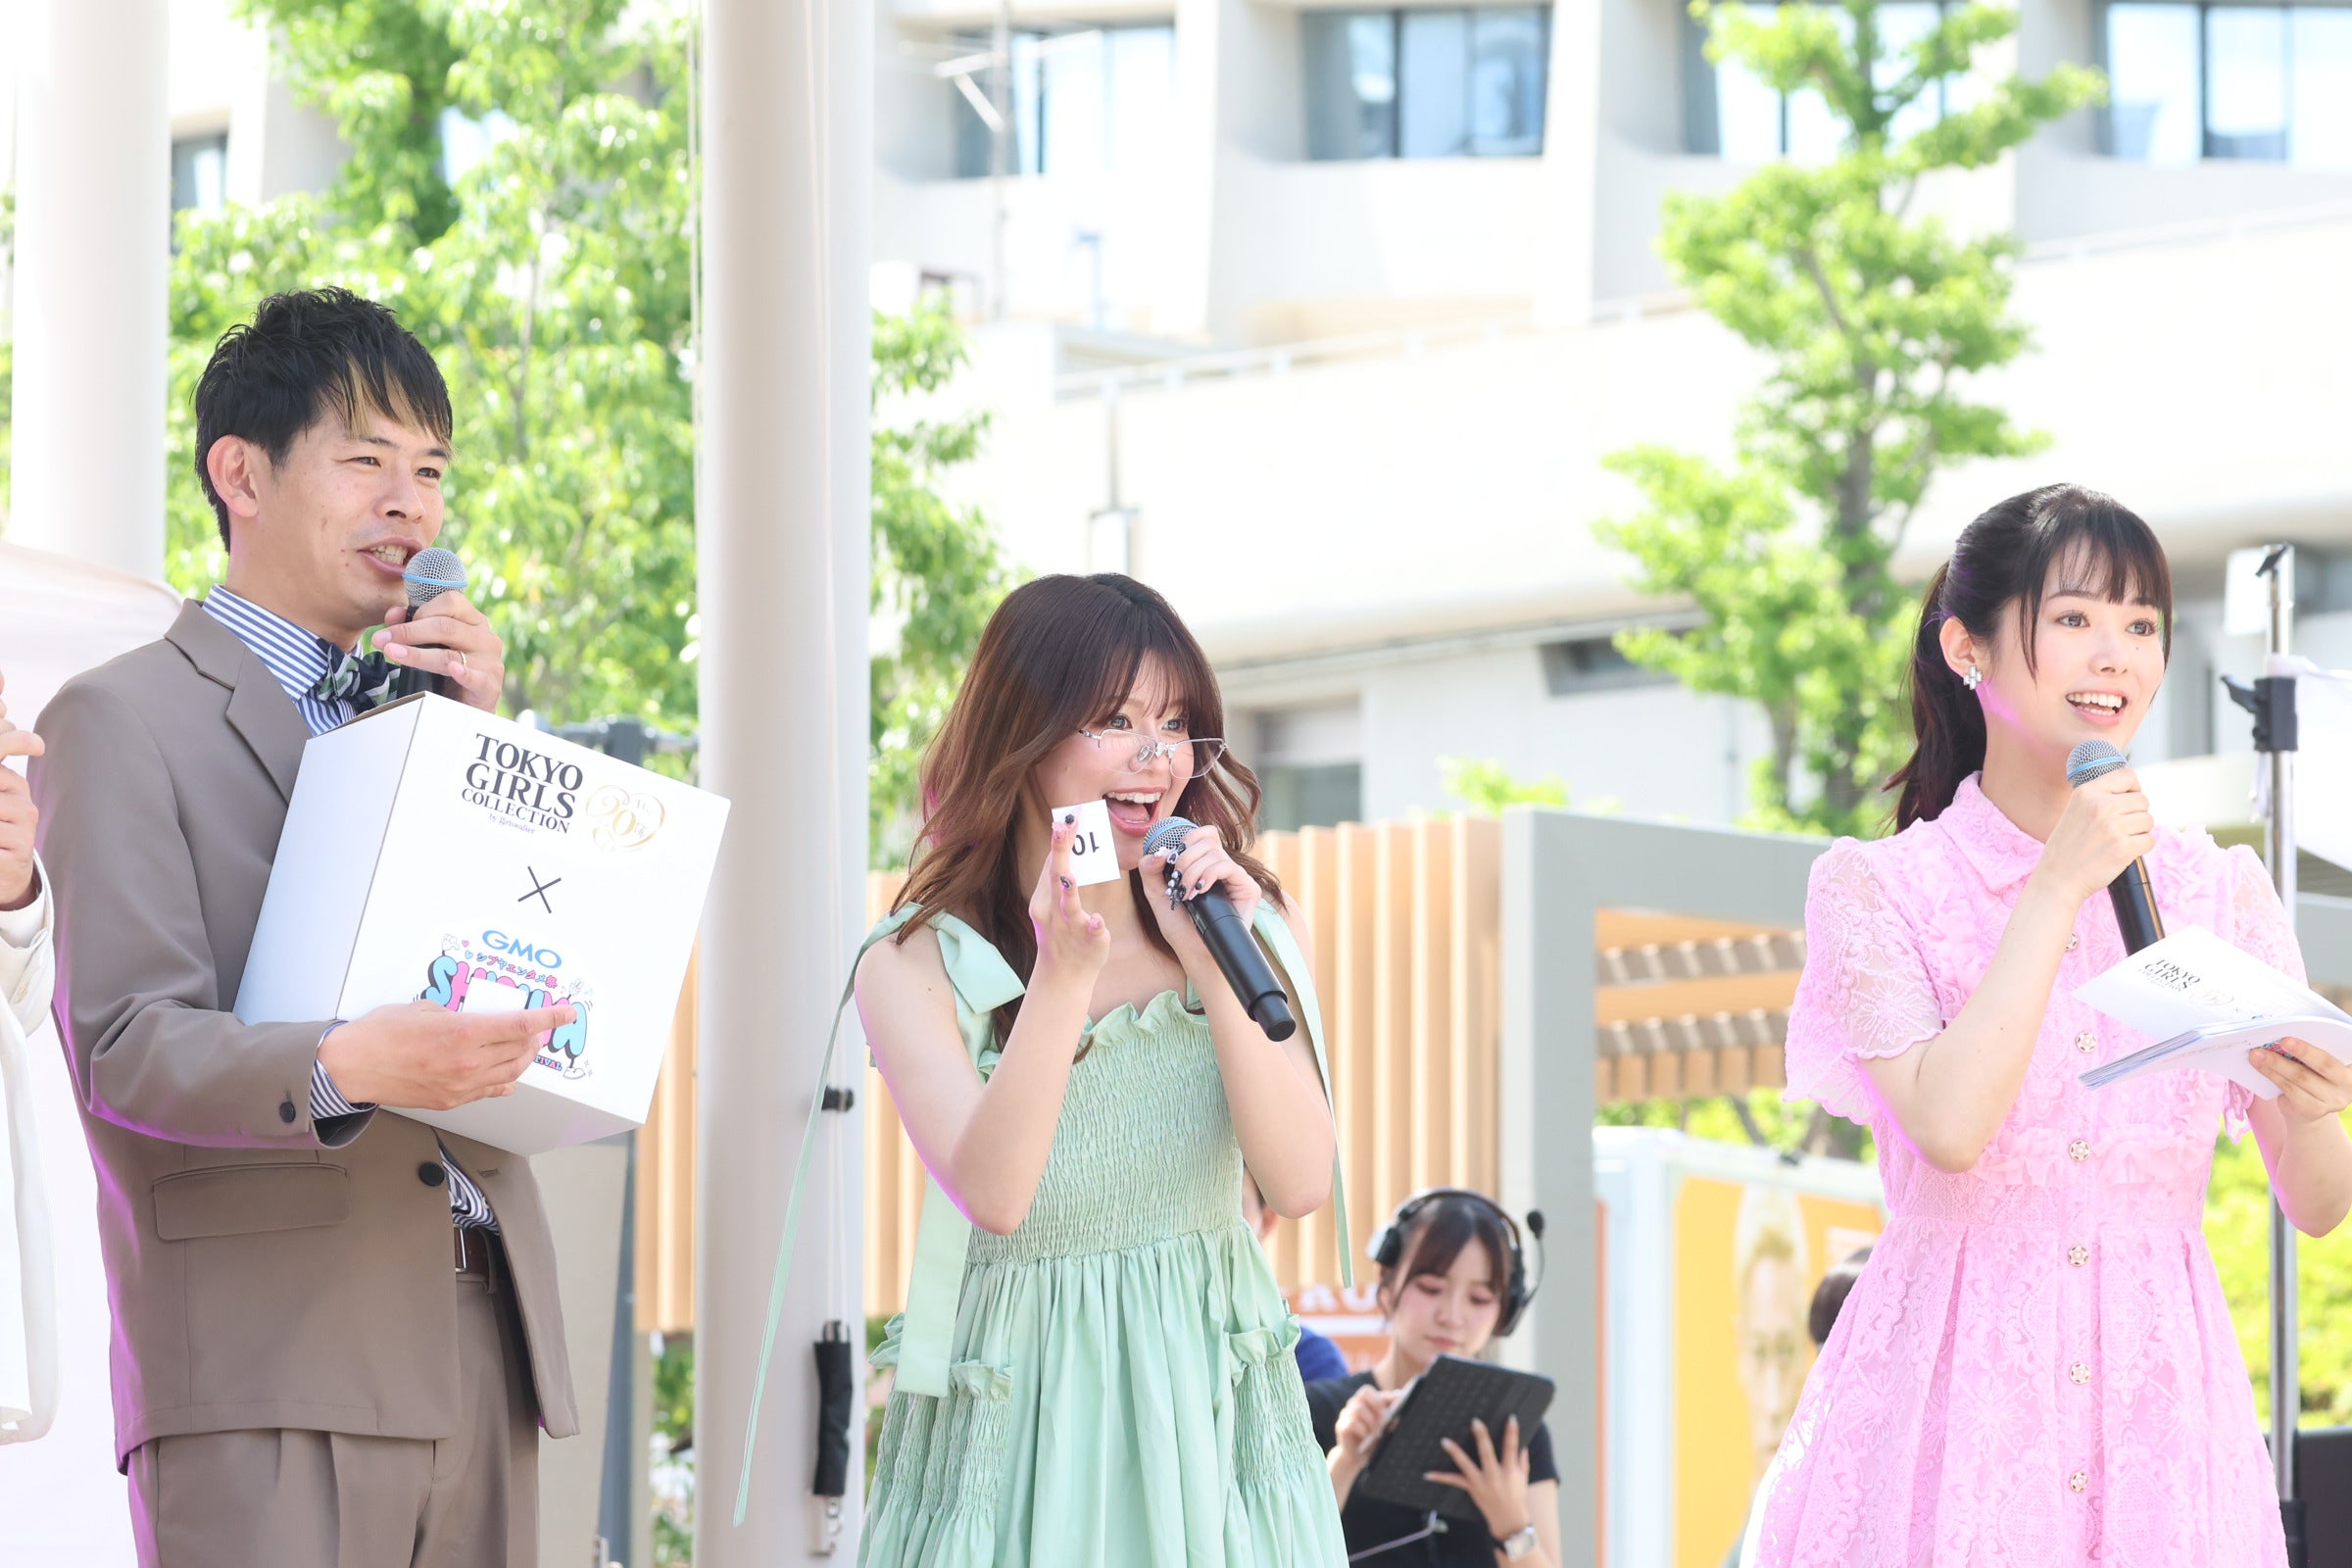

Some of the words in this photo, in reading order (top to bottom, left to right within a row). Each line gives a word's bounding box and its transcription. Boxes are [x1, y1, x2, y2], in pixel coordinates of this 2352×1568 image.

[475, 733, 583, 791] TOKYO
[462, 788, 570, 834] COLLECTION
[466, 762, 575, 818] GIRLS
[482, 930, 562, 968] GMO
[2144, 963, 2188, 989] GIRLS
[2155, 958, 2200, 983] TOKYO
